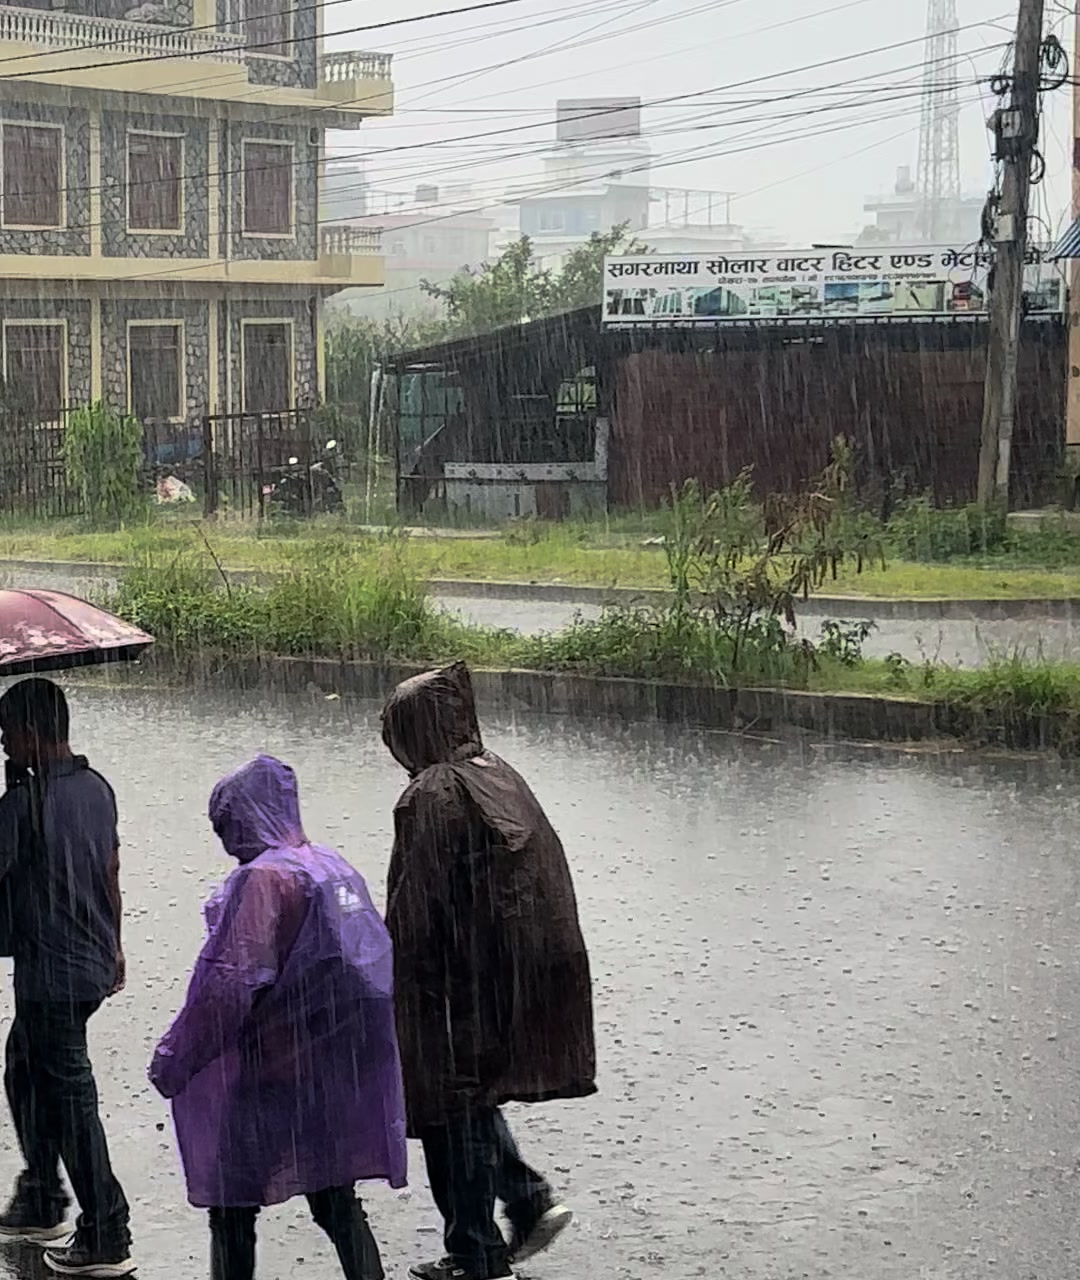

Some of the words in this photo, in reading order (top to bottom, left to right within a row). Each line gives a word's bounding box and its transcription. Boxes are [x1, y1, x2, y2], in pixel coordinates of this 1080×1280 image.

[608, 260, 700, 278] सगरमाथा
[706, 256, 771, 275] सोलार
[777, 257, 826, 272] वाटर
[832, 252, 883, 271] हिटर
[890, 253, 935, 269] एण्ड
